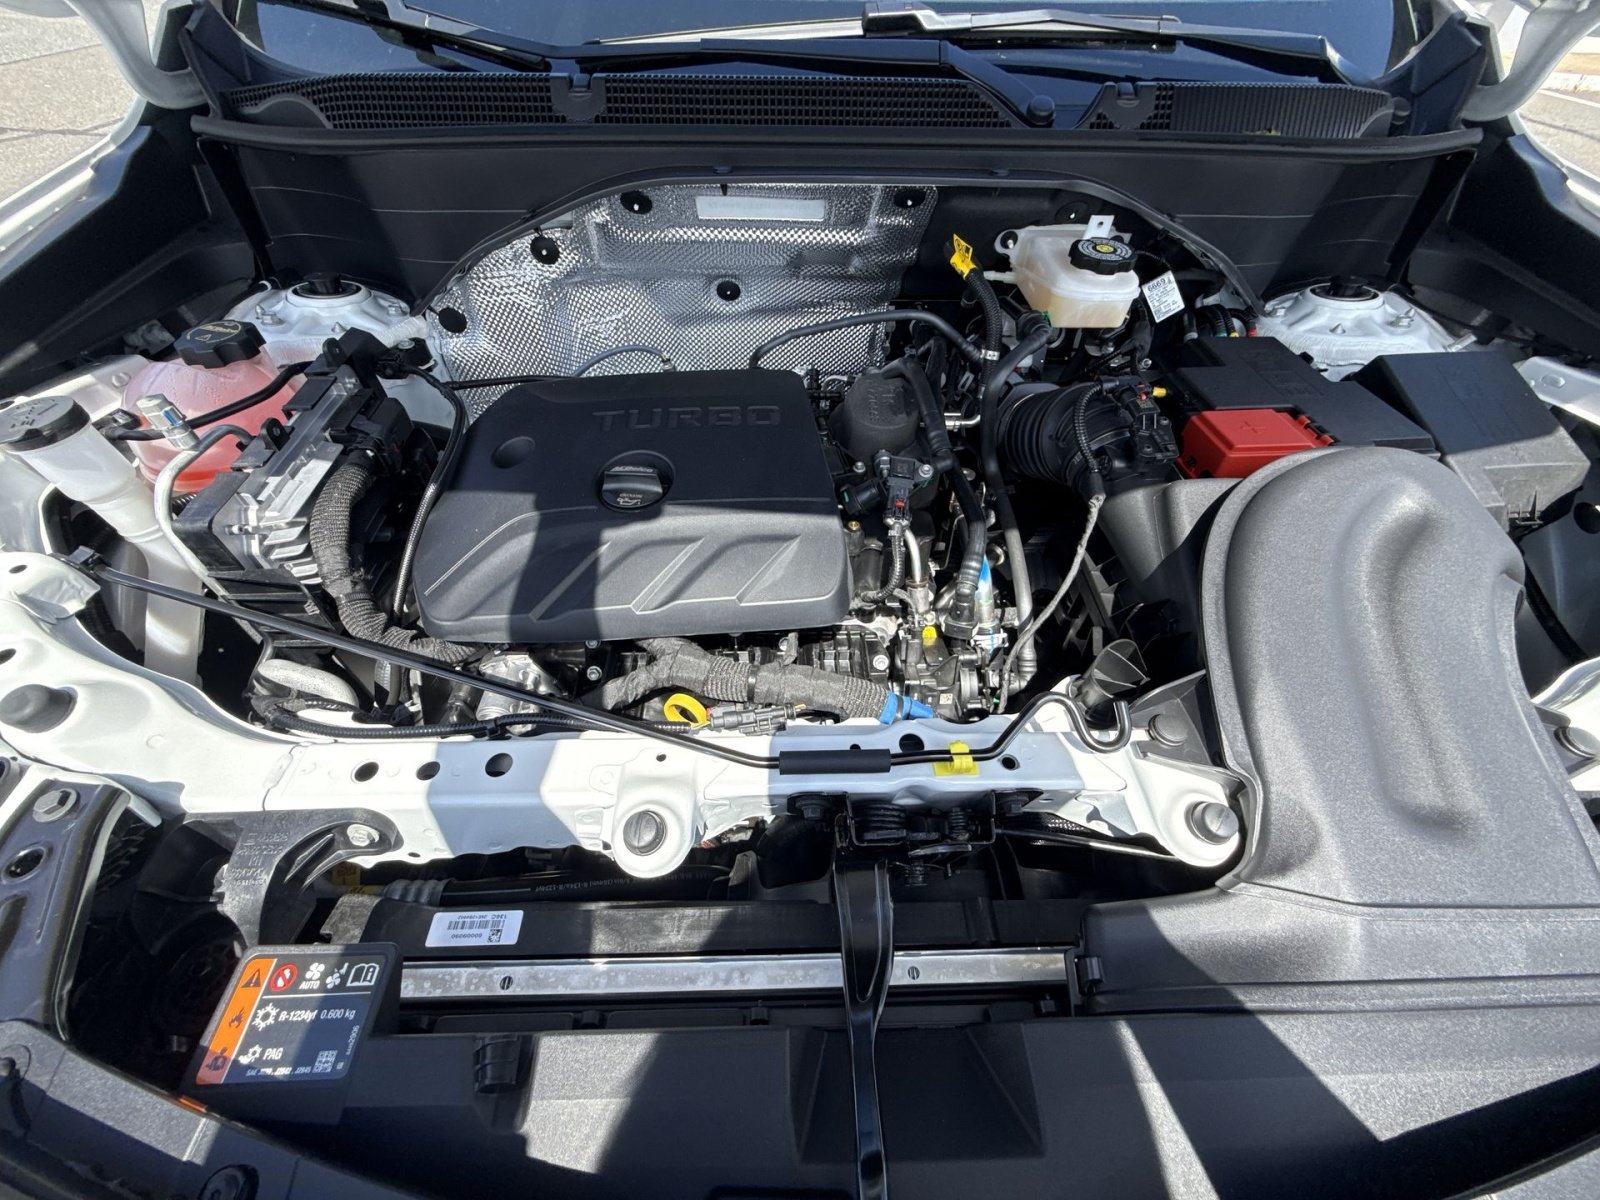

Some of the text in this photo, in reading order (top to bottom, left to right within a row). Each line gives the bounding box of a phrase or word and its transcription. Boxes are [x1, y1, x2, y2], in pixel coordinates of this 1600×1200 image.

[592, 406, 780, 431] TURBO
[299, 981, 320, 990] AUTO
[278, 1008, 356, 1022] R-1234yf 0.600 kg
[263, 1048, 284, 1060] PAG
